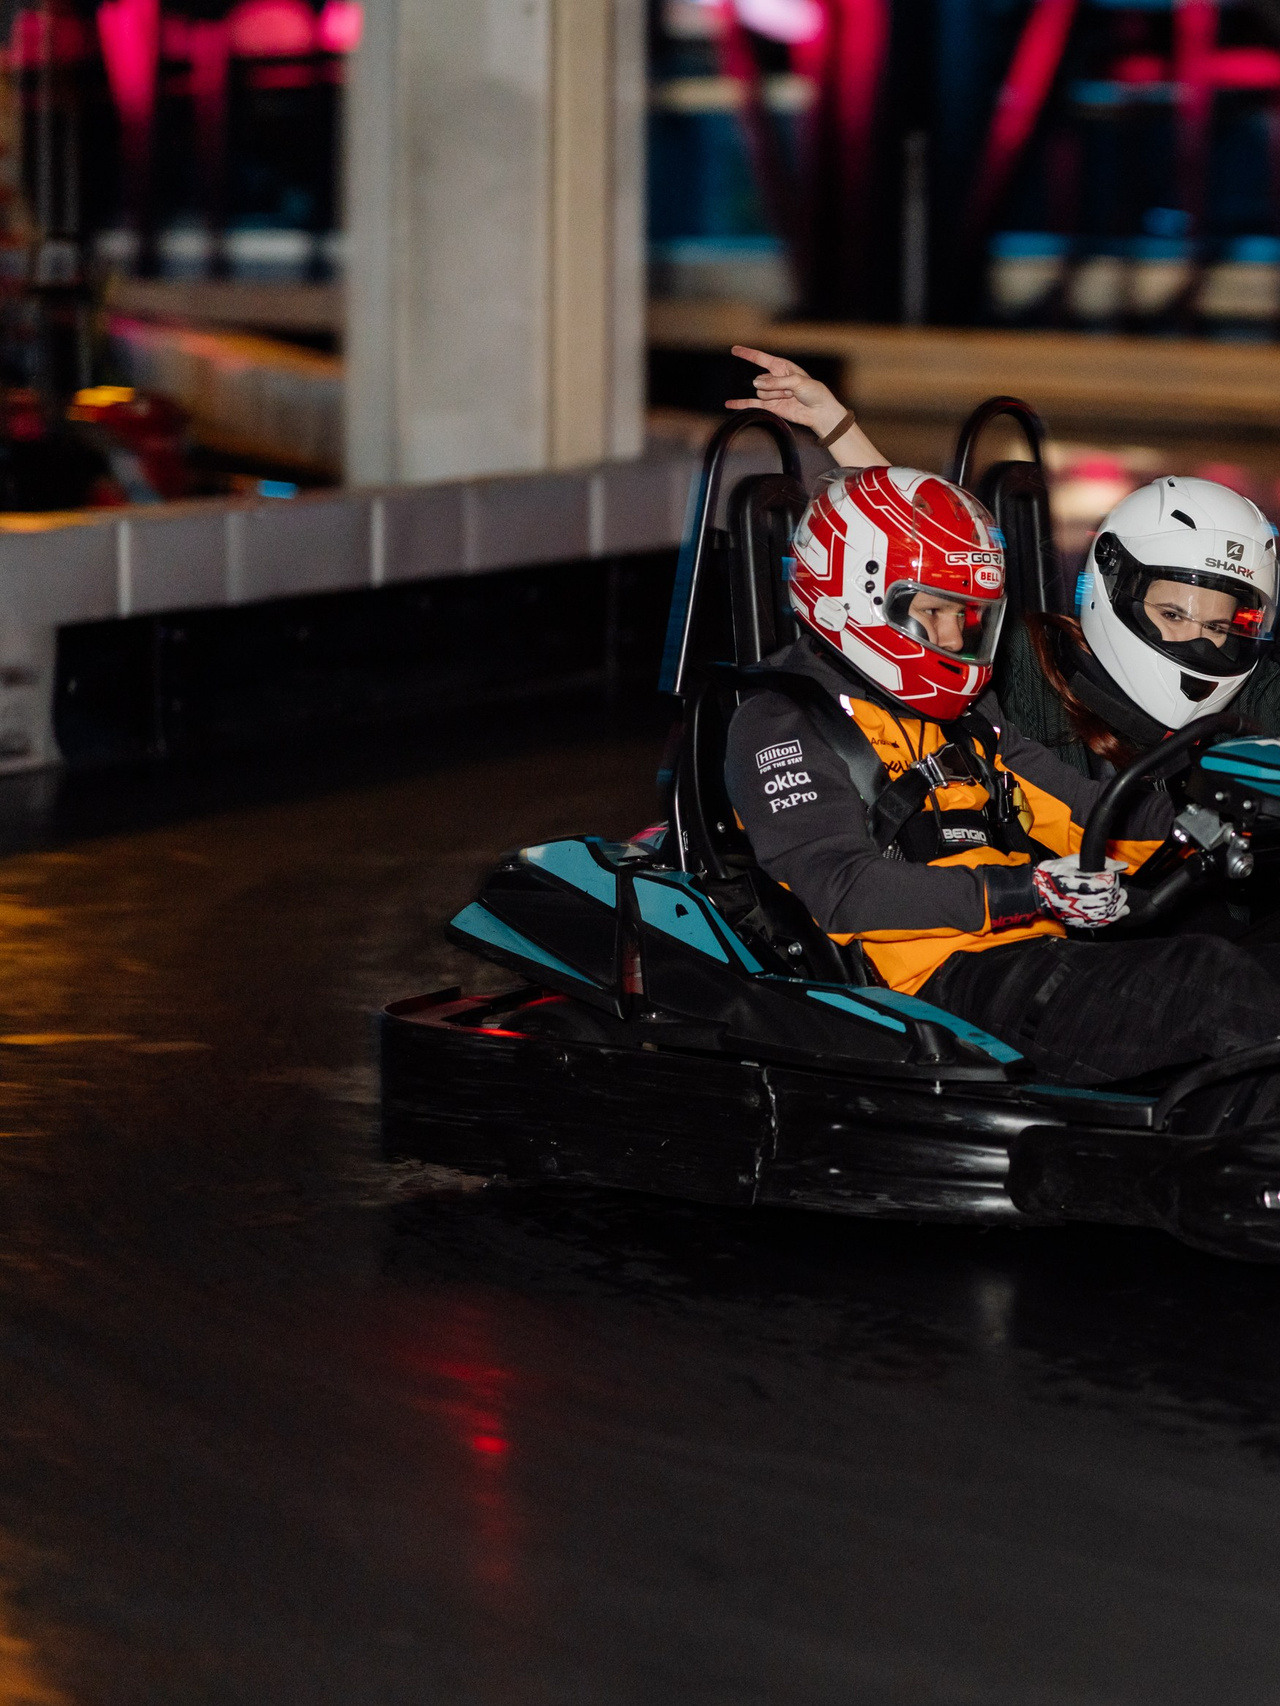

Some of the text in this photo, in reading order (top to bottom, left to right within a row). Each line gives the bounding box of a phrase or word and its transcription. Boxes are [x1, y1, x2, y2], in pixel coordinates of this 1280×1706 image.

[980, 571, 999, 582] BELL
[1204, 557, 1255, 580] SHARK
[758, 745, 798, 764] Hilton
[759, 756, 803, 774] FOR THE STAY
[764, 771, 812, 795] okta
[769, 791, 818, 814] FxPro
[941, 828, 987, 842] BENGIO
